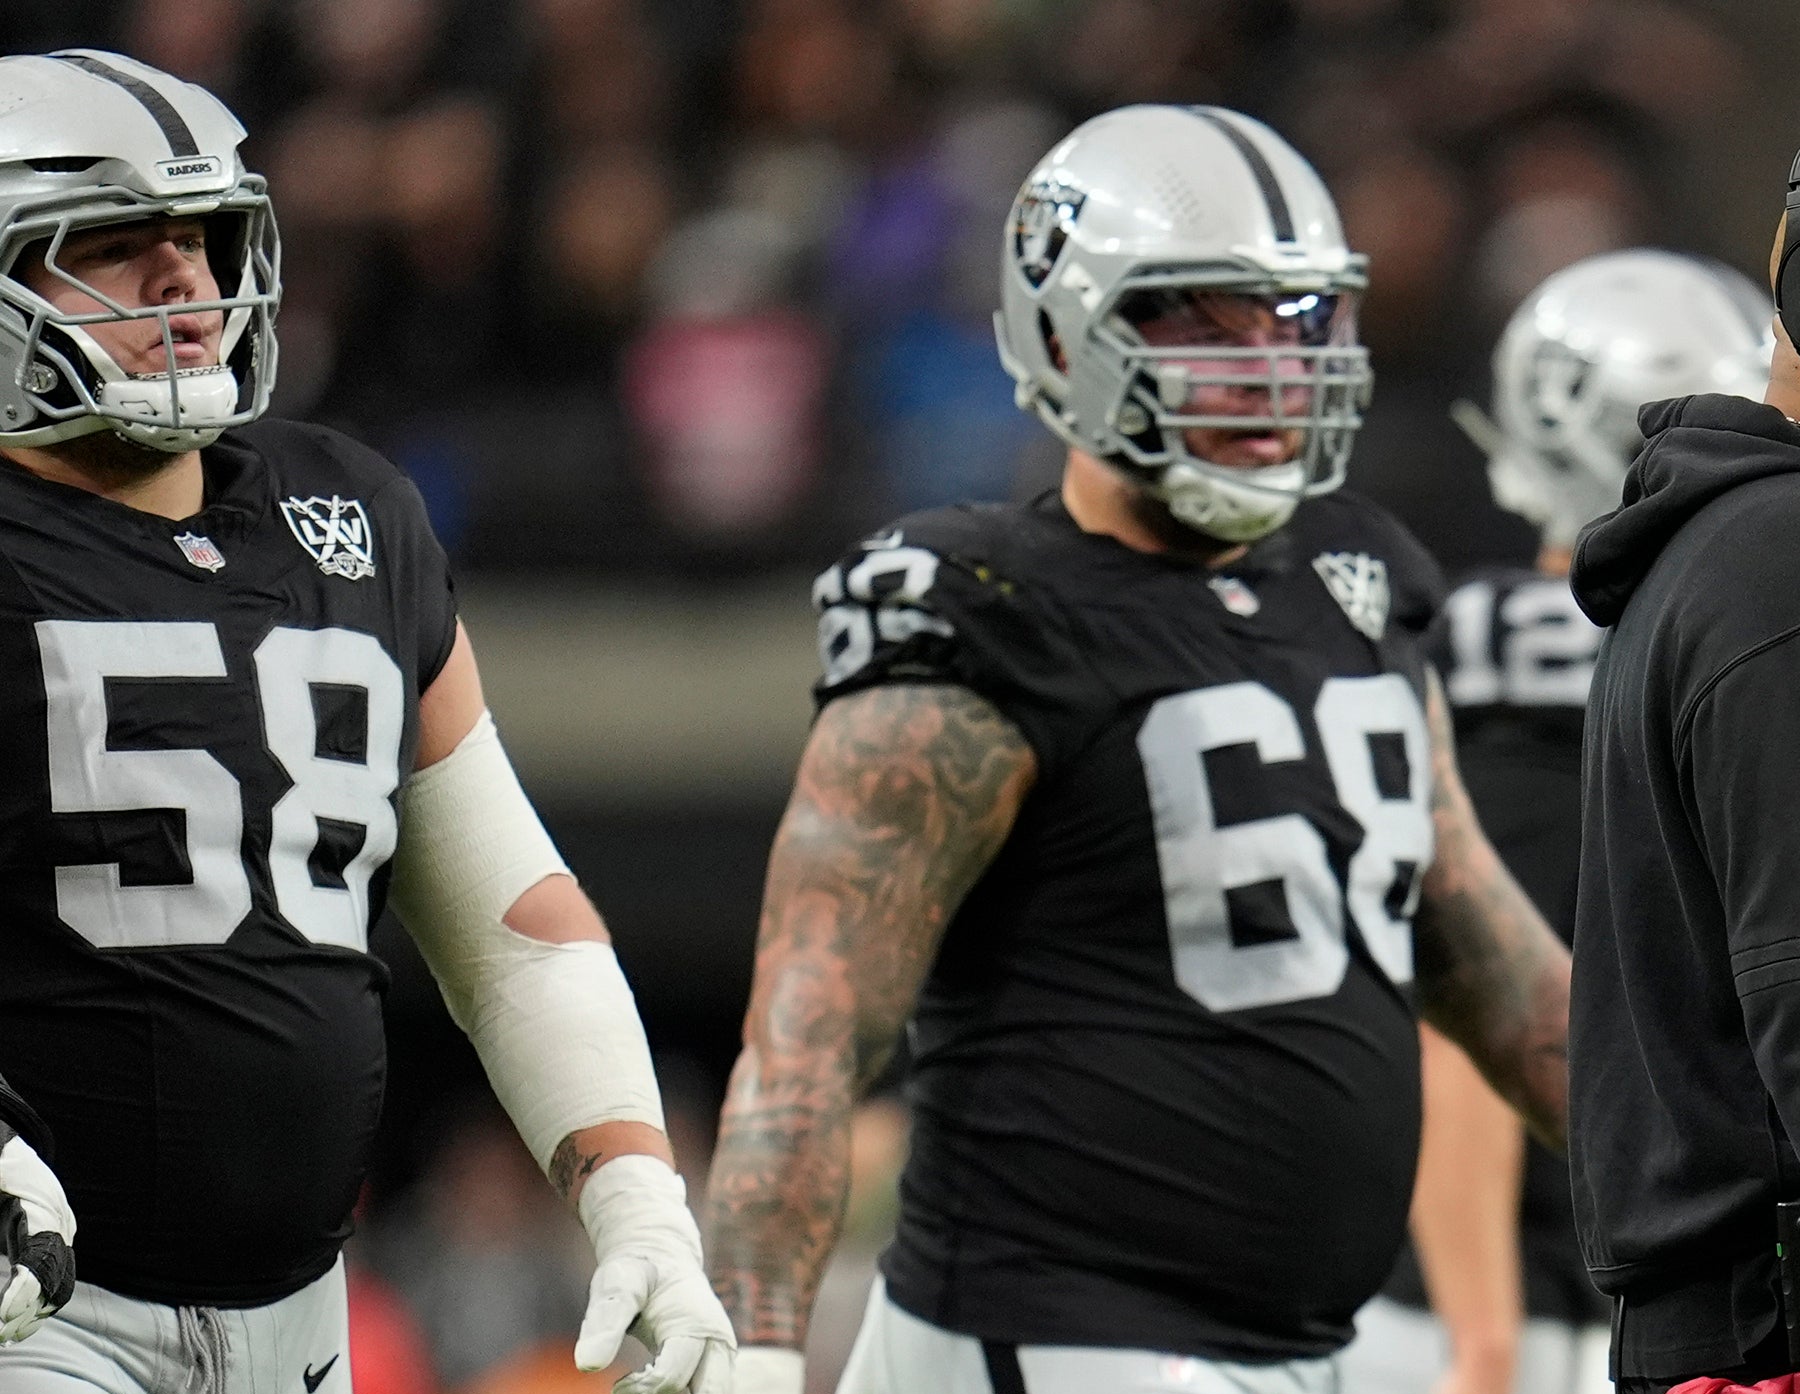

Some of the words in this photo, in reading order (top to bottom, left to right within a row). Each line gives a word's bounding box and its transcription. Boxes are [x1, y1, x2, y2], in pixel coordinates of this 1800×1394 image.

[167, 163, 212, 177] RAIDERS
[190, 549, 218, 563] NFL
[1445, 579, 1600, 706] 12
[34, 620, 404, 953] 58
[1136, 672, 1435, 1013] 68
